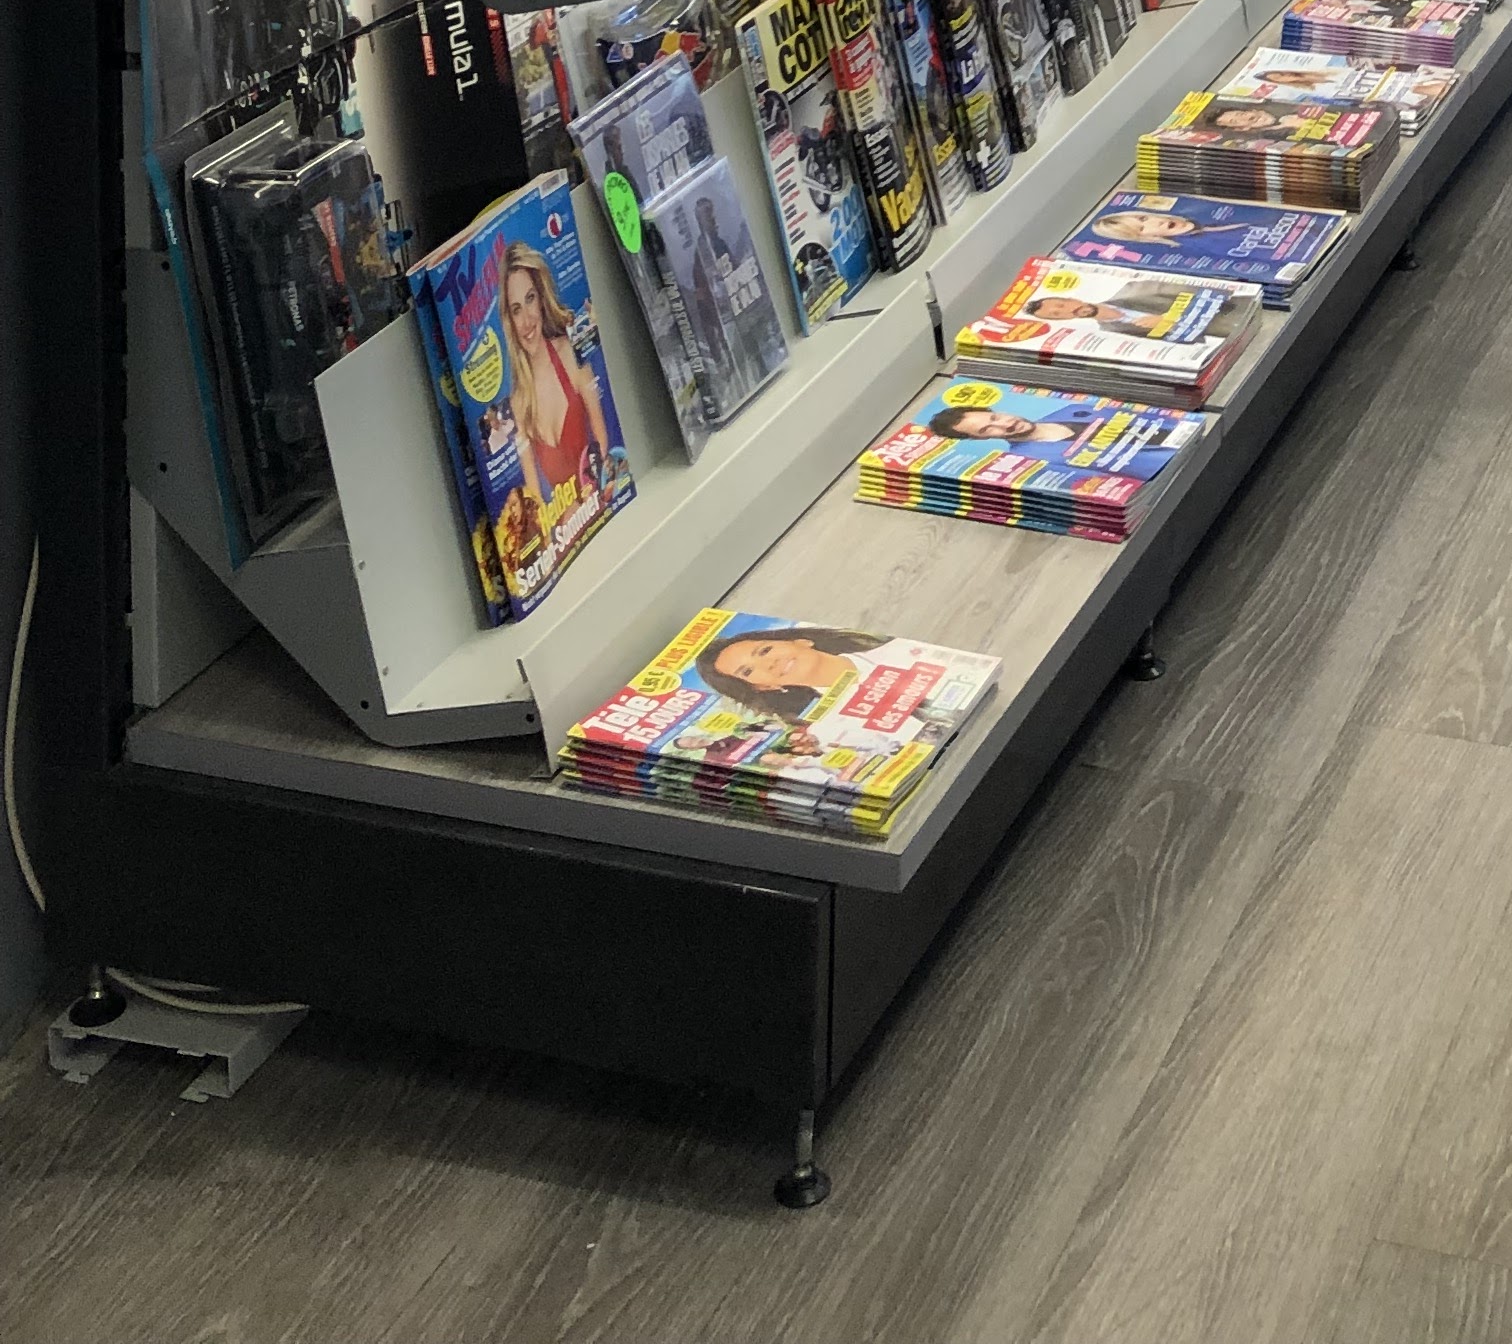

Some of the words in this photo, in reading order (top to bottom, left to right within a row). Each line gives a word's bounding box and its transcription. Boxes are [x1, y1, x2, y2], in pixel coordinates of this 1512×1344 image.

[515, 488, 601, 596] Serien-Sommer
[582, 686, 663, 735] Télé
[853, 700, 875, 718] La
[872, 669, 903, 707] saison
[871, 711, 893, 730] des
[887, 671, 934, 716] amours
[623, 720, 656, 746] 15
